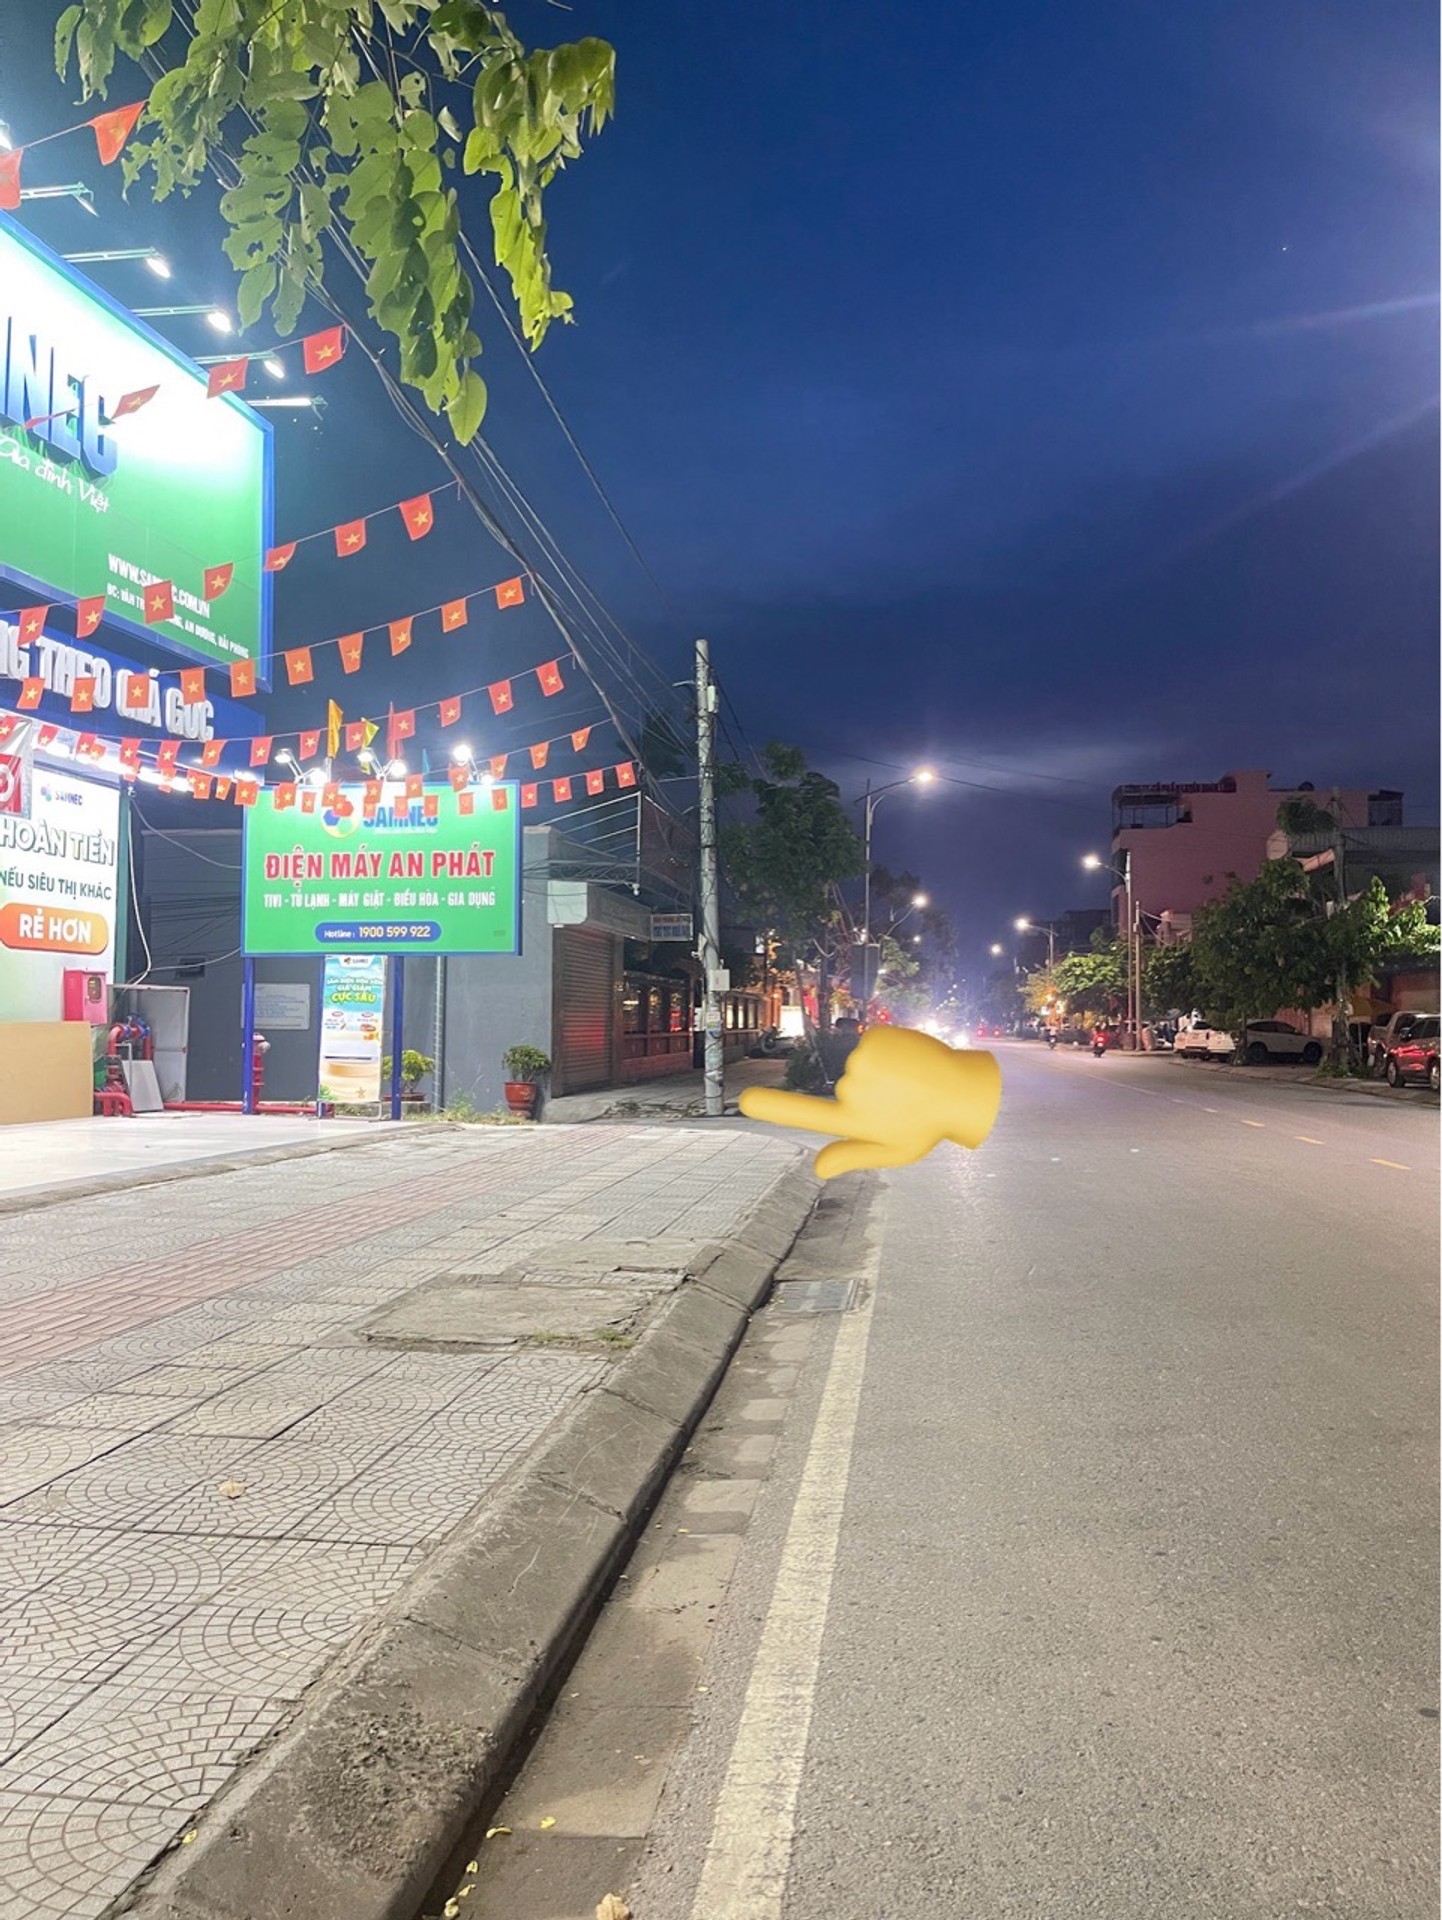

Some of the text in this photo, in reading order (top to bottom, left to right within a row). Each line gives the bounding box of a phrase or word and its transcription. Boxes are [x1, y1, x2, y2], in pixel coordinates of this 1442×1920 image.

[0, 312, 118, 476] NEC
[34, 458, 72, 495] đình
[78, 477, 109, 514] Việt
[184, 620, 194, 635] AN
[116, 668, 162, 728] GÁ
[0, 818, 67, 858] HOÀN
[0, 865, 112, 900] NẾU SIÊU THỊ KHÁC
[265, 841, 495, 887] ĐIỆN MÁY AN PHÁT
[264, 894, 282, 908] TIVI
[305, 893, 330, 911] LẠNH
[339, 889, 360, 908] MÁY
[418, 889, 440, 906] HÒA
[447, 892, 465, 906] GIA
[468, 891, 496, 909] DỤNG
[19, 907, 92, 945] RẺ HƠN
[359, 926, 384, 938] 1900
[387, 926, 408, 938] 599
[409, 925, 431, 938] 922
